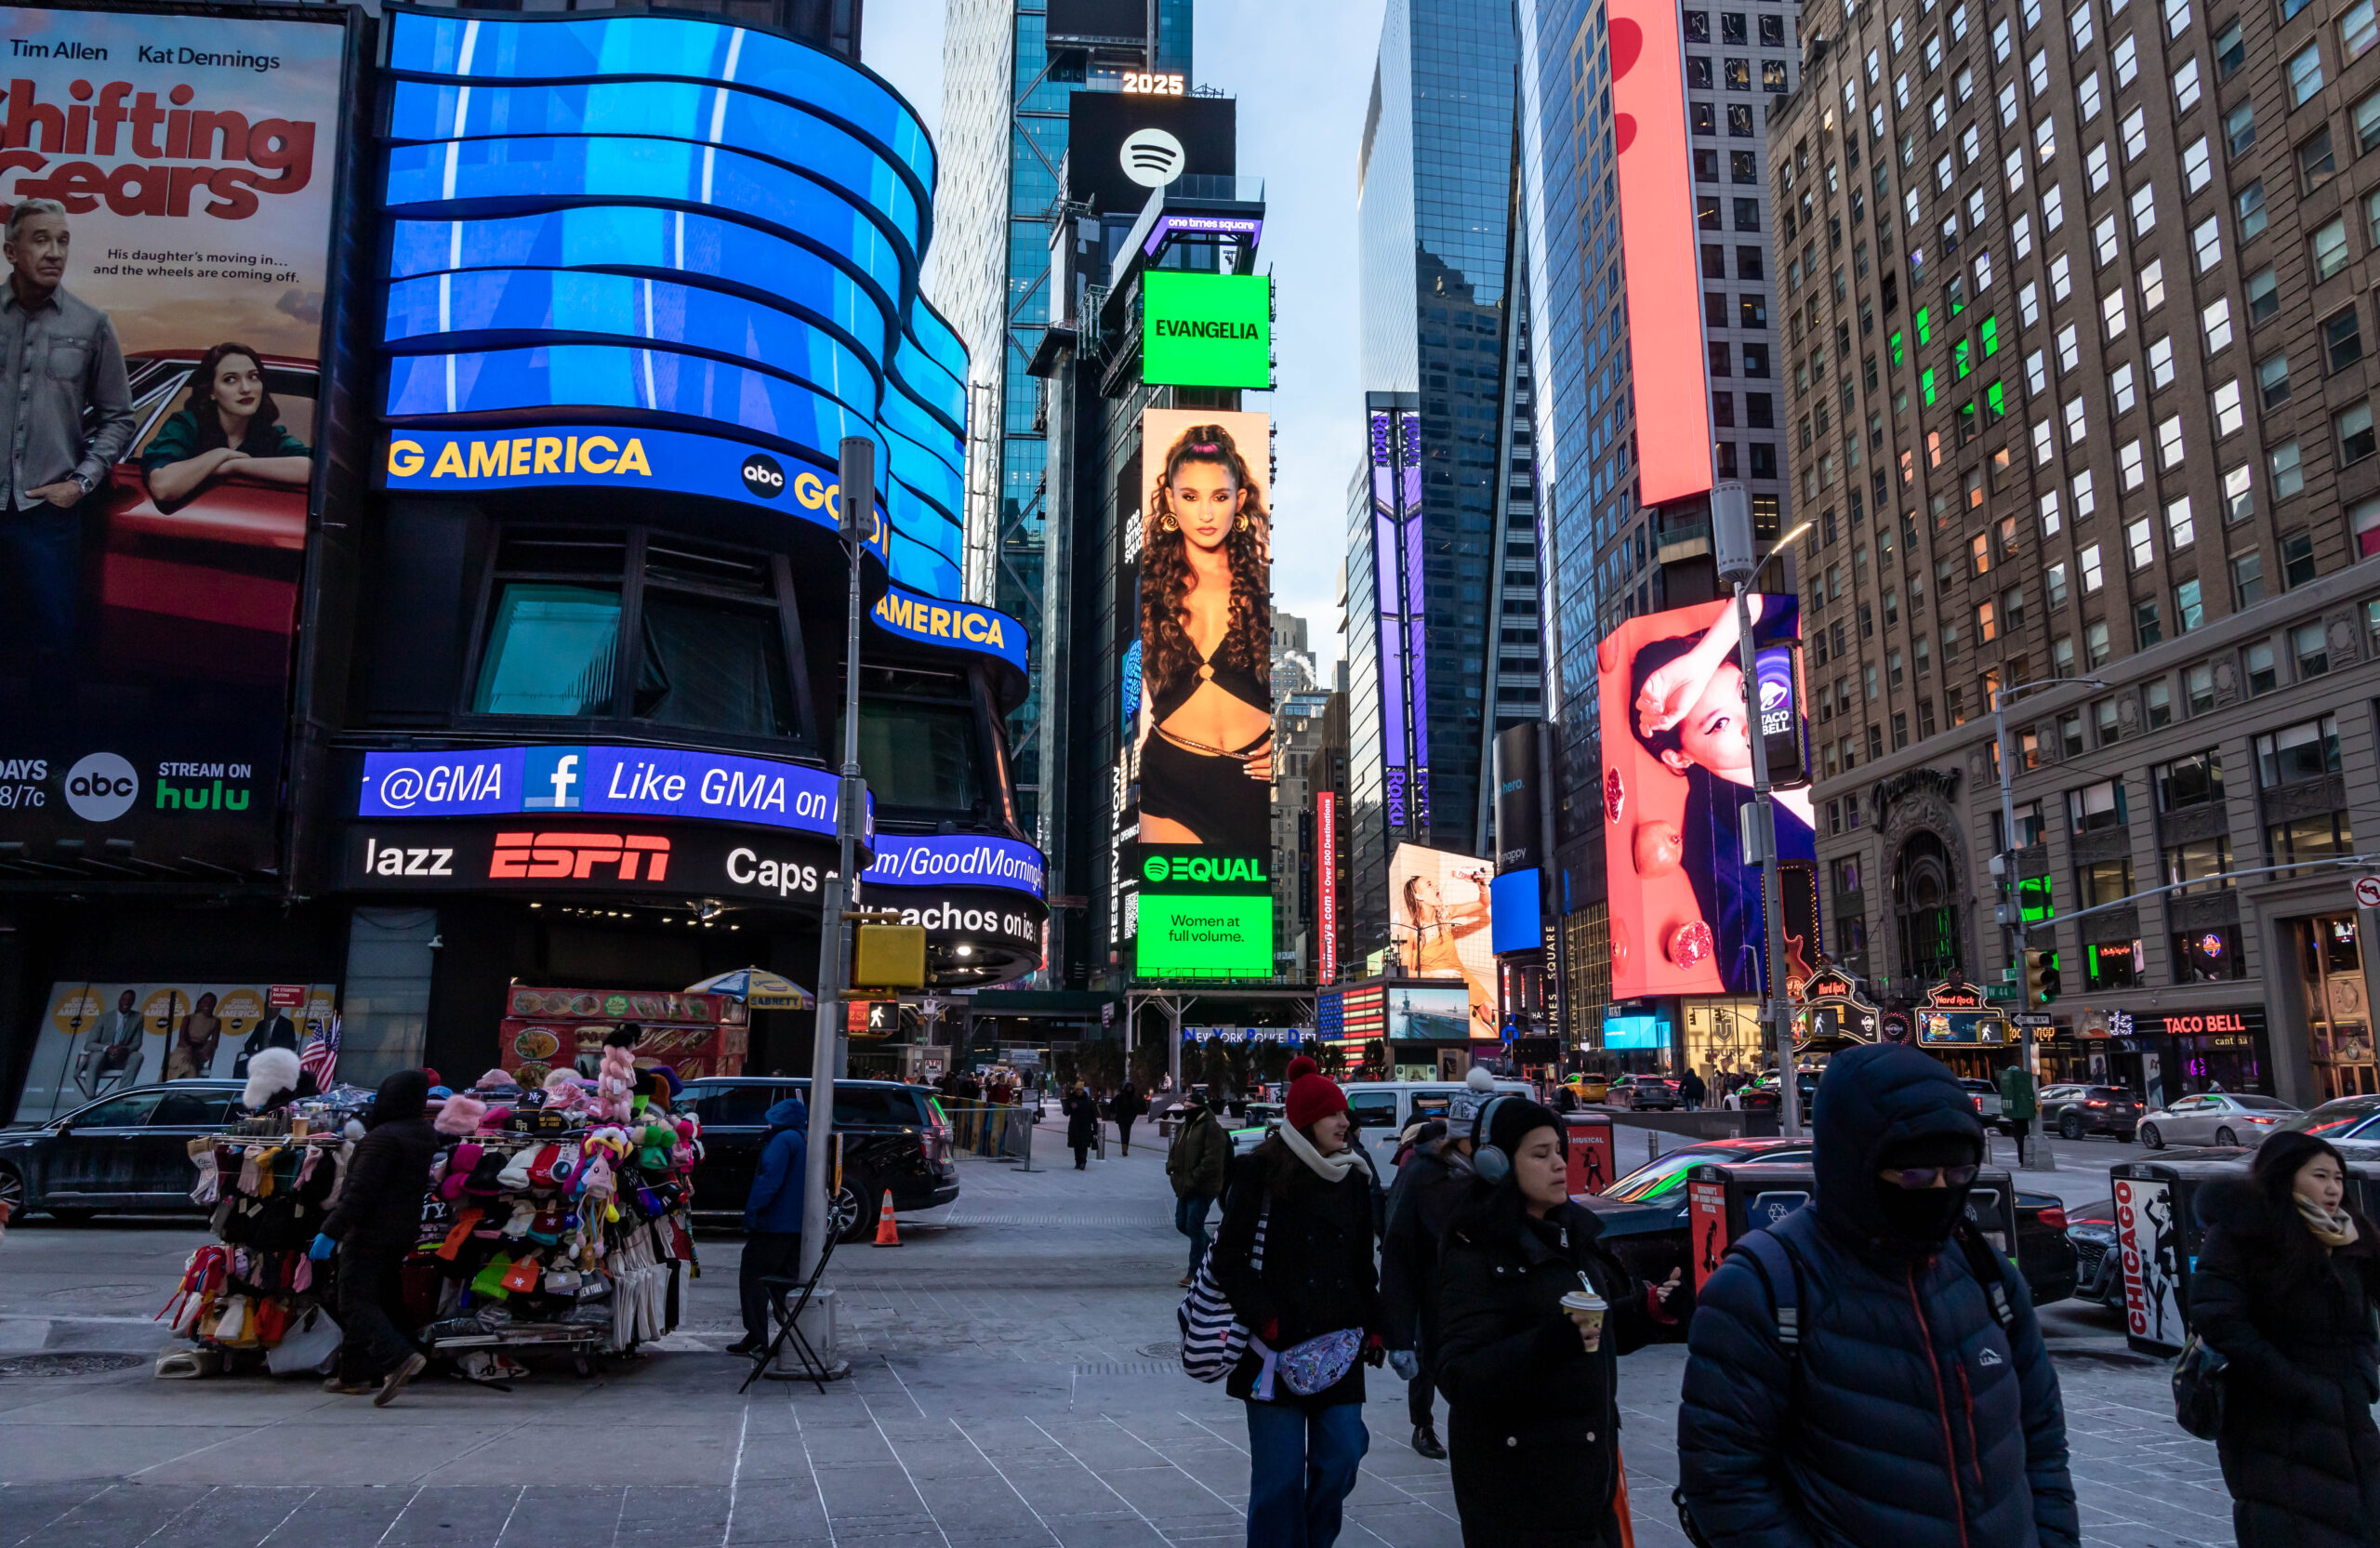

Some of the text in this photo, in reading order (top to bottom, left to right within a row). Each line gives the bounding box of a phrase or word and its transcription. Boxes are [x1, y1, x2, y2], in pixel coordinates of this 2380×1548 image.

[10, 40, 281, 71] Tim Allen Kat Dennings
[1123, 72, 1183, 95] 2025
[0, 78, 315, 194] hifting
[1169, 218, 1254, 232] one times square
[107, 248, 128, 261] His
[131, 248, 204, 266] daughter's
[206, 252, 258, 268] moving
[93, 264, 300, 284] and the wheels are coming off.
[1156, 319, 1259, 340] EVANGELIA
[430, 435, 654, 480] AMERICA
[743, 464, 786, 490] abc
[876, 594, 1004, 649] AMERICA
[1761, 709, 1789, 724] TACO
[1762, 721, 1791, 734] BELL
[159, 762, 251, 778] STREAM ON
[70, 772, 134, 798] abc
[156, 779, 250, 811] hulu
[380, 762, 502, 809] @GMA
[608, 762, 686, 803] Like
[701, 769, 786, 813] GMA
[796, 791, 826, 819] on
[1388, 772, 1406, 827] ROKU
[490, 832, 671, 882] ESPN
[1501, 848, 1526, 865] snappy
[726, 847, 818, 898] Caps
[1172, 856, 1266, 882] EQUAL
[1324, 867, 1332, 886] Over
[1111, 833, 1119, 944] RESERVE
[1004, 914, 1022, 937] on
[1170, 915, 1239, 927] Women at
[1169, 930, 1245, 943] full volume.
[1546, 925, 1558, 1035] TIMES SQUARE
[1818, 982, 1846, 996] Hard Rock
[750, 996, 799, 1007] SABRETT
[1937, 996, 1975, 1006] Hard Rock
[1999, 988, 2008, 997] 44
[218, 1010, 259, 1018] AMERICA
[1608, 1006, 1621, 1017] AT&T
[2163, 1014, 2245, 1034] TACO BELL
[1184, 1027, 1211, 1042] NEW
[1213, 1027, 1243, 1043] YORK
[2215, 1037, 2247, 1046] cantna
[528, 1092, 542, 1104] NY
[2115, 1182, 2147, 1335] CHICAGO
[589, 1283, 603, 1294] YORK
